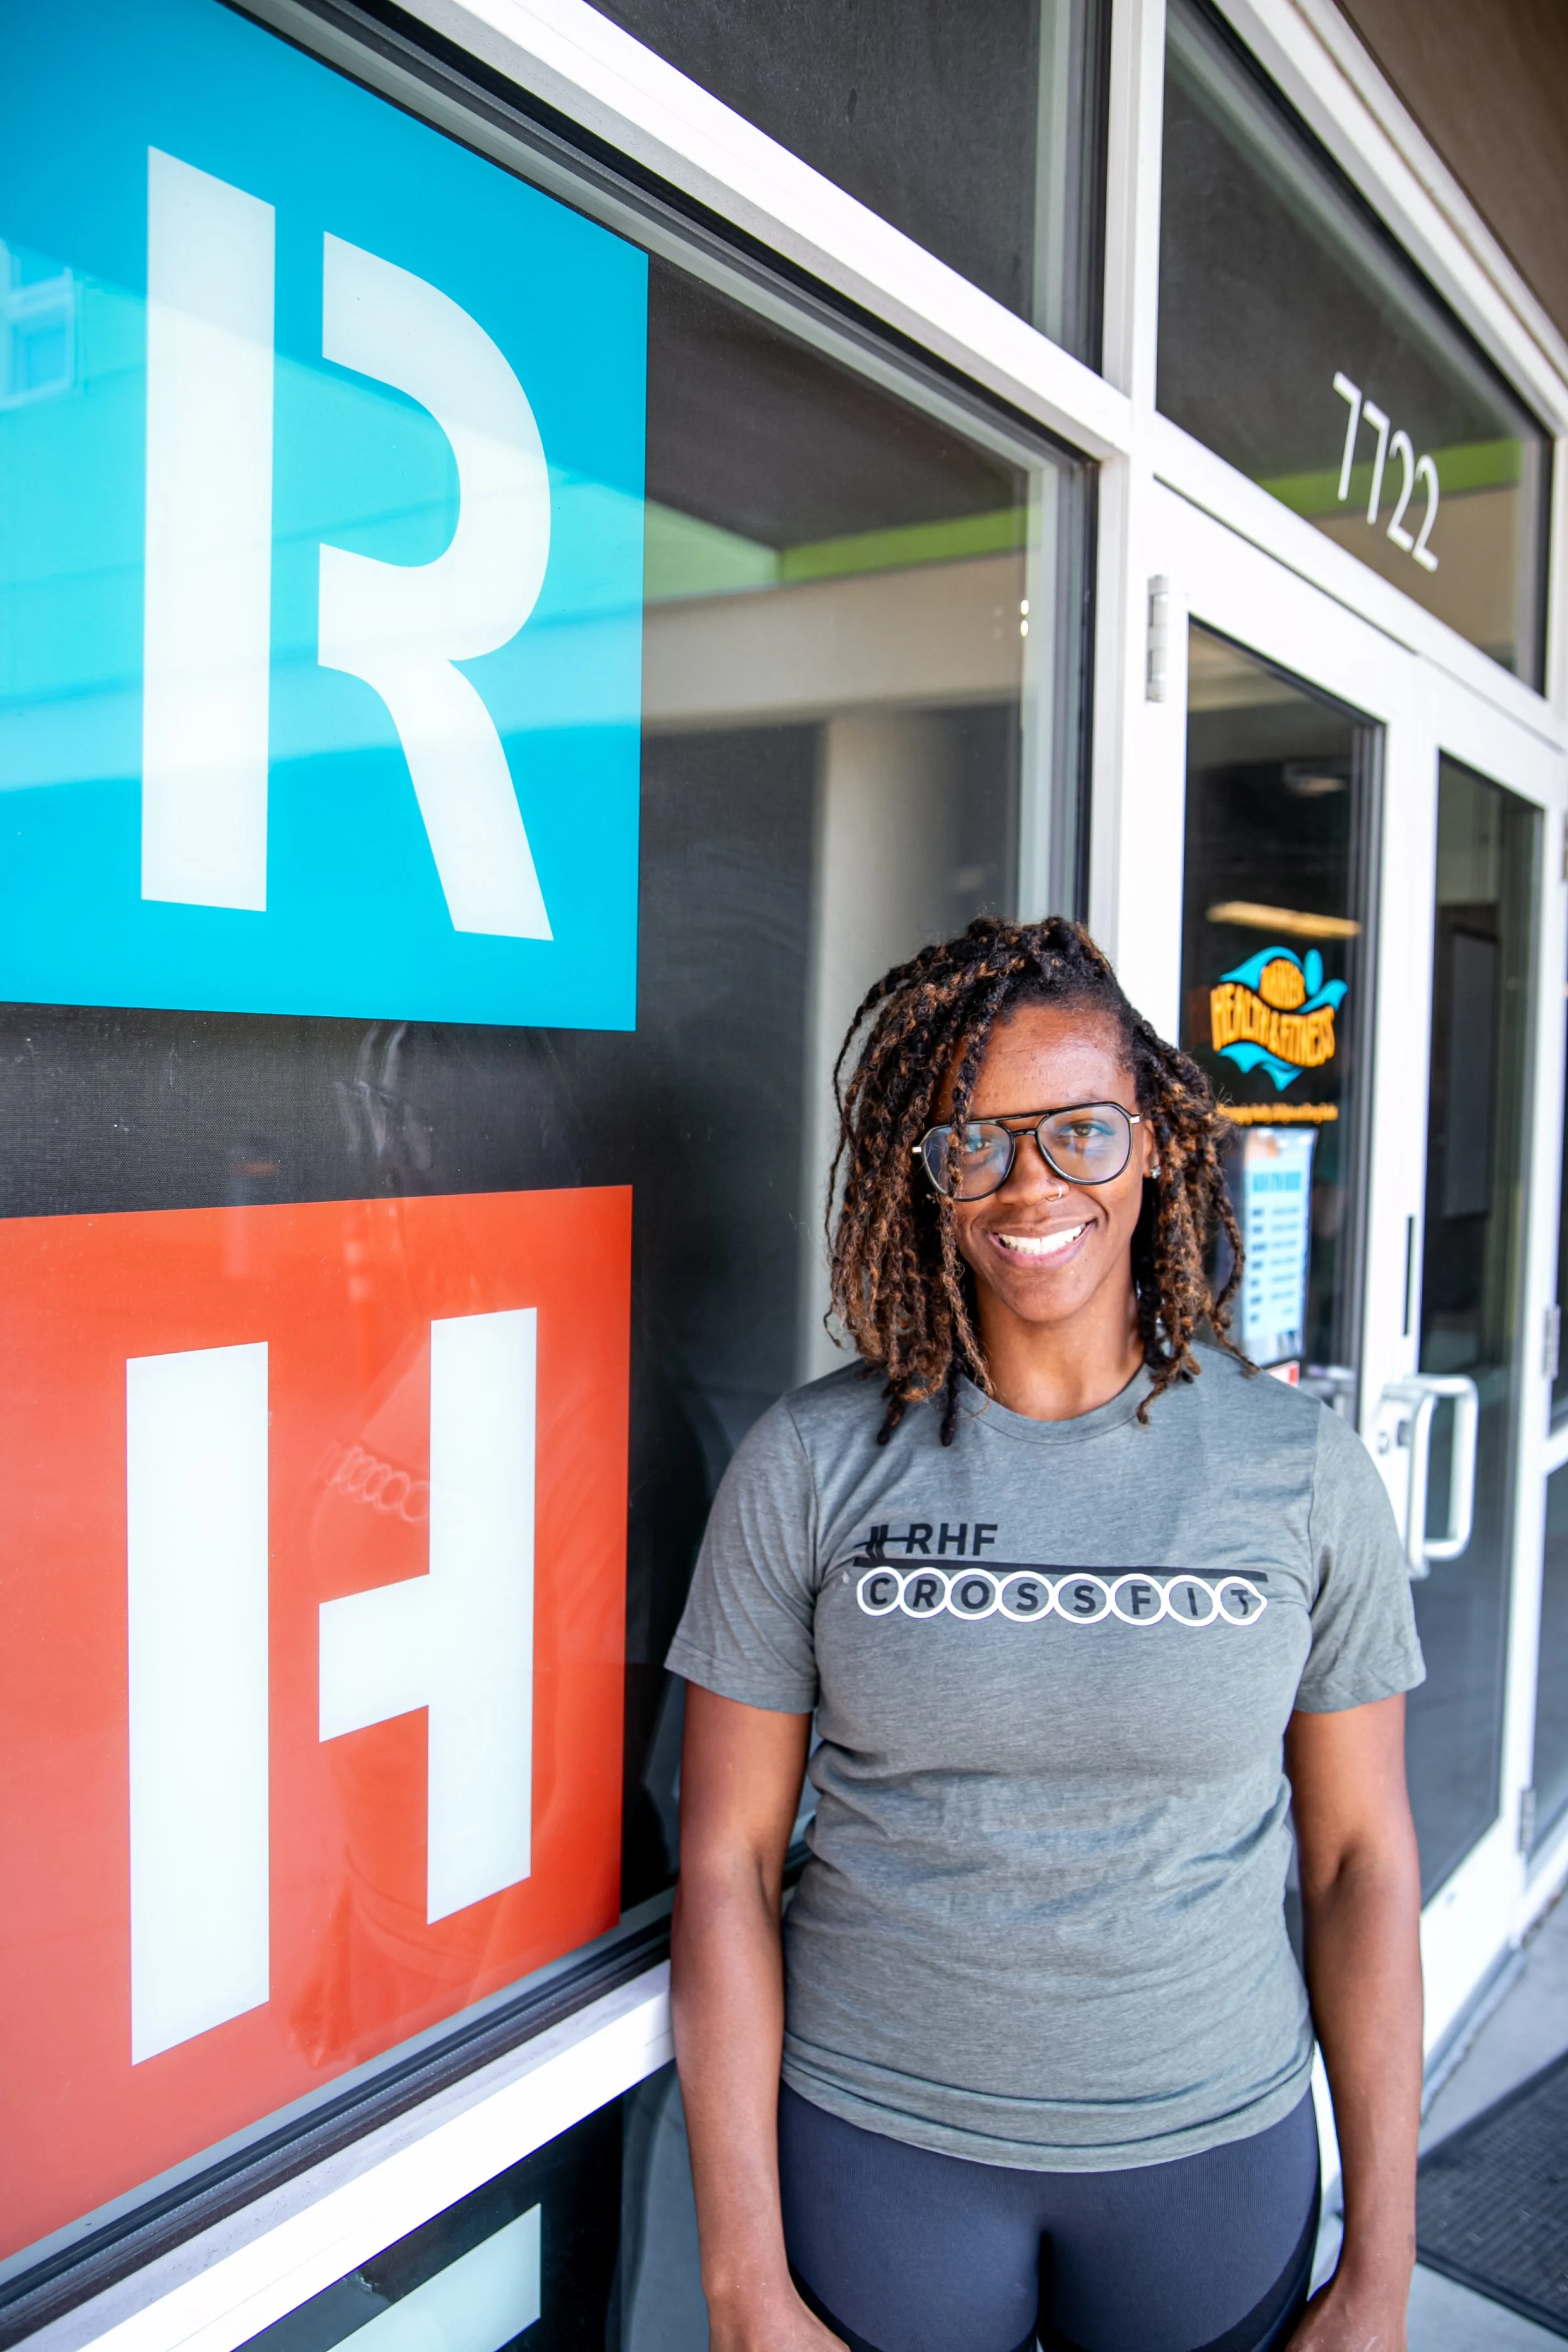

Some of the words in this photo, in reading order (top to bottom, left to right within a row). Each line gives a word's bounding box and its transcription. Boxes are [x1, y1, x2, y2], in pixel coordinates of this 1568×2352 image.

[140, 144, 555, 942] R
[1332, 371, 1439, 573] 7722
[869, 1577, 1249, 1616] CROSSFIT
[905, 1523, 999, 1557] RHF
[125, 1306, 538, 2067] H
